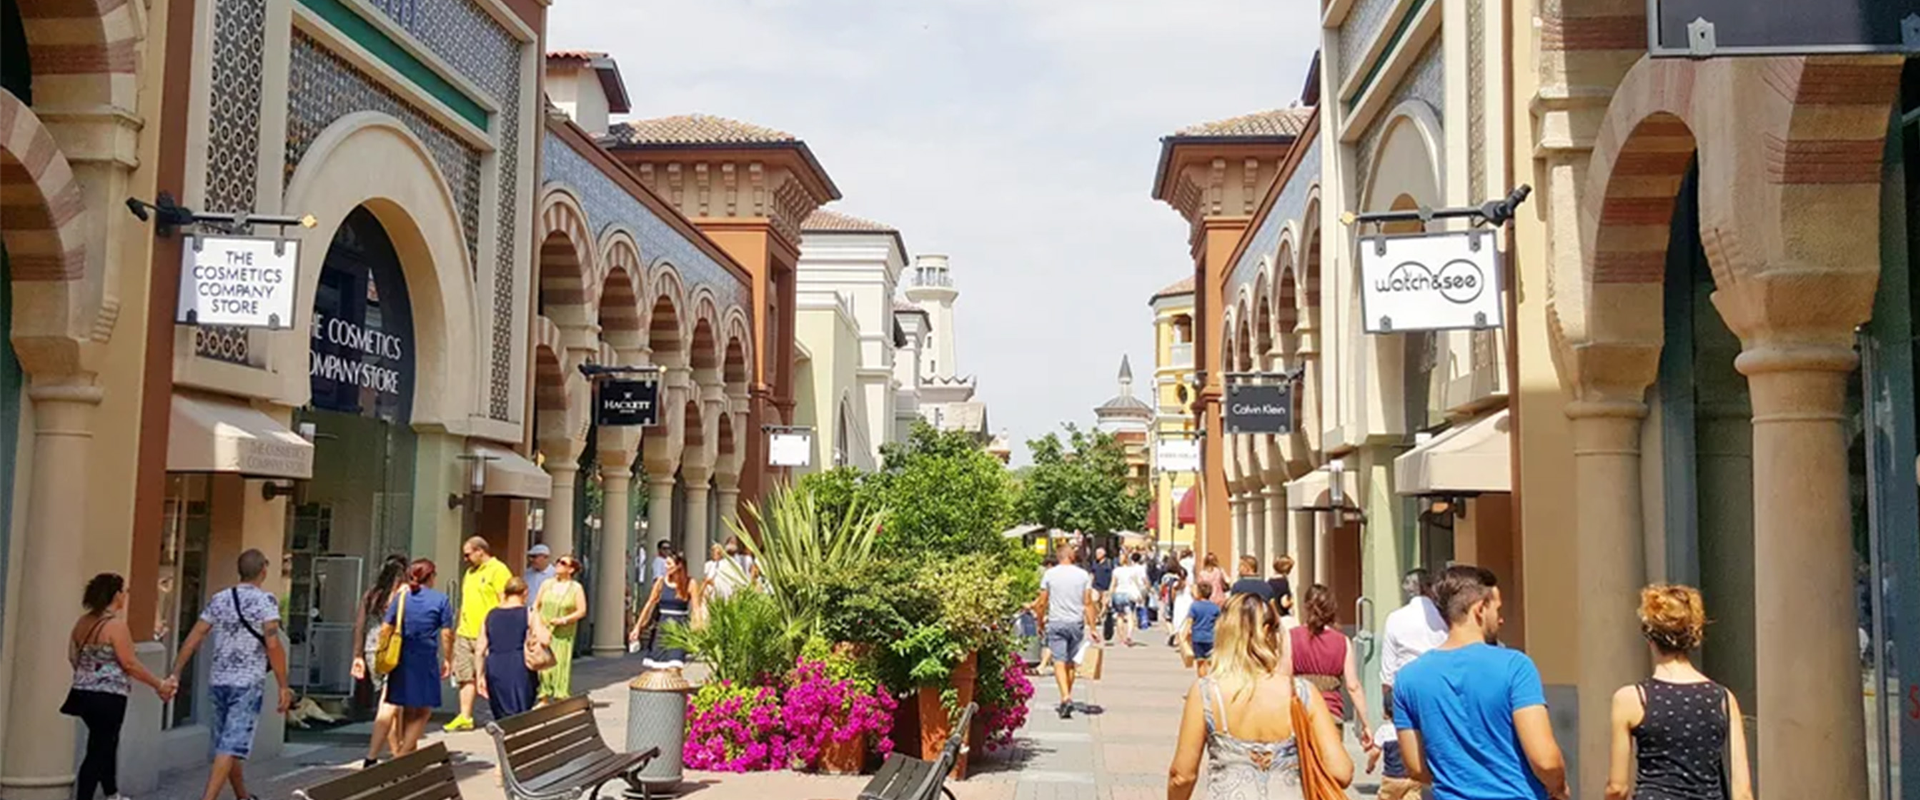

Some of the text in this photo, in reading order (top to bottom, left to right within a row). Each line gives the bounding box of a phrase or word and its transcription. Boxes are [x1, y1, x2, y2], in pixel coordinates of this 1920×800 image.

[225, 251, 254, 266] THE
[192, 265, 283, 284] COSMETICS
[1374, 268, 1477, 293] watch&see
[198, 282, 275, 299] COMPANY
[211, 299, 259, 315] STORE
[328, 317, 403, 361] COSMETICS
[361, 363, 400, 395] STORE
[1232, 403, 1286, 415] Calvin Klein
